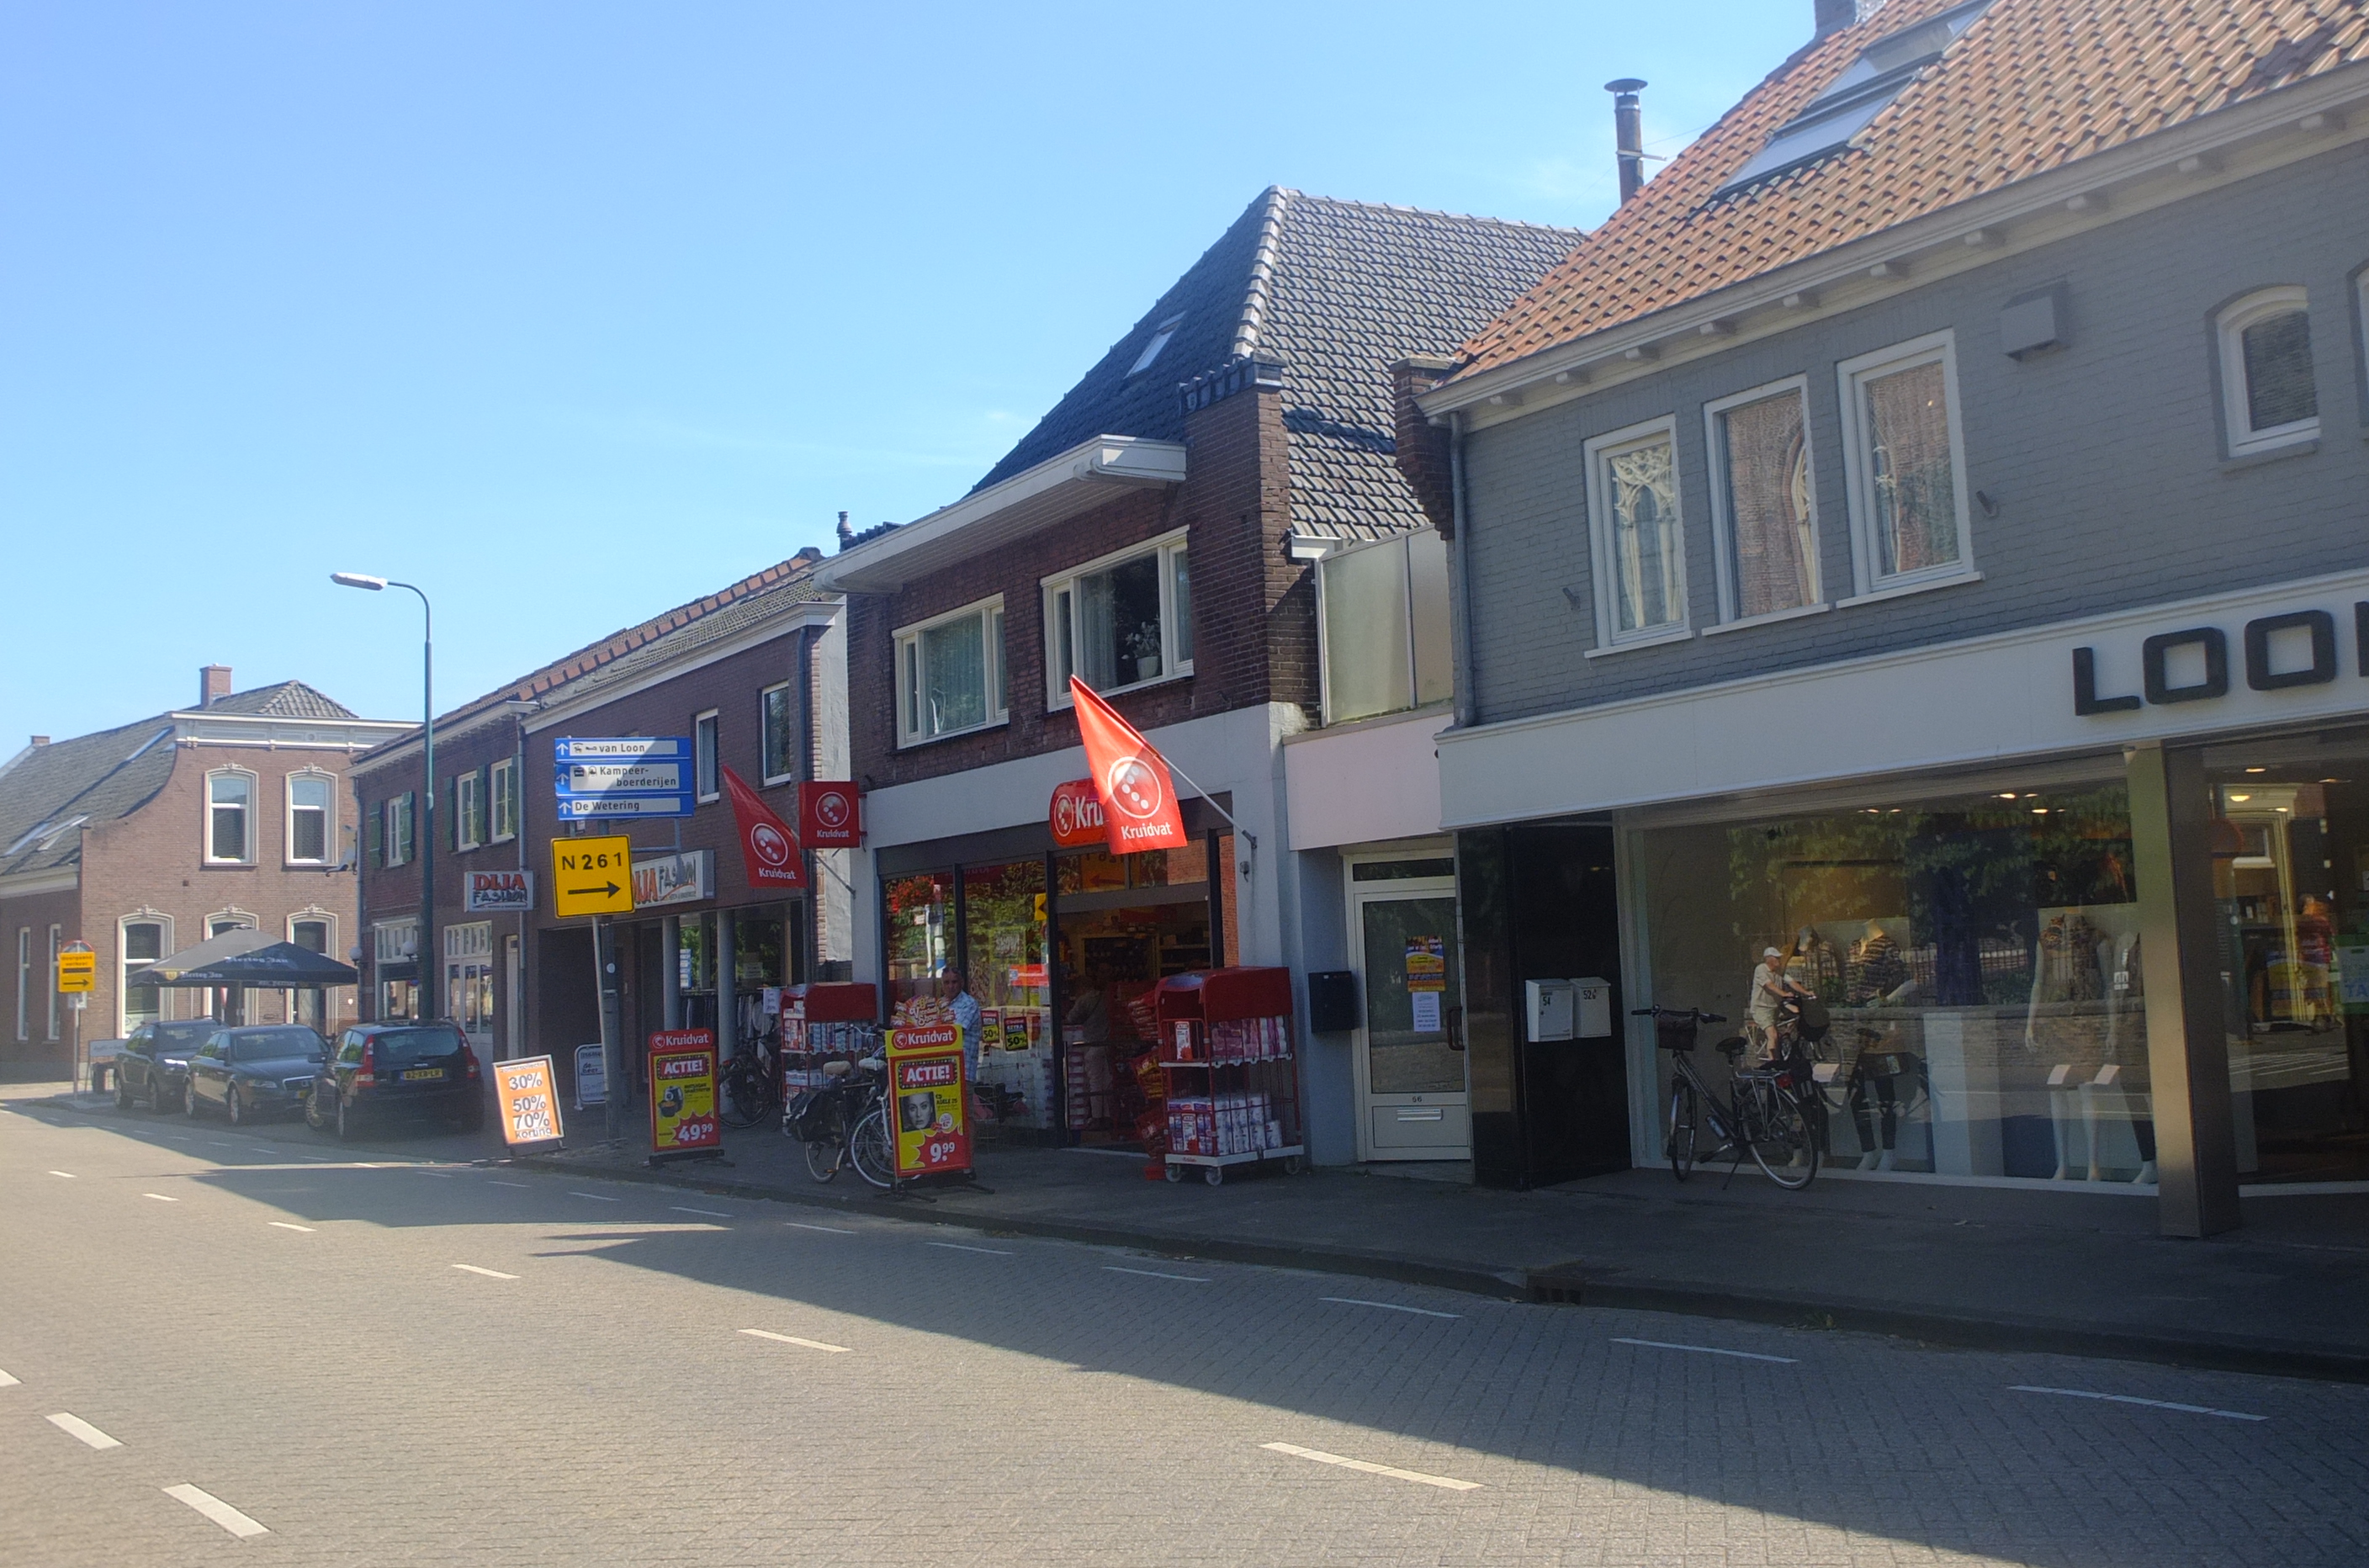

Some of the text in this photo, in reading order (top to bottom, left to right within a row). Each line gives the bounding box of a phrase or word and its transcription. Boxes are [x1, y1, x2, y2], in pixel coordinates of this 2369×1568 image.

[621, 744, 645, 752] Loon
[600, 766, 649, 776] Kampeer-
[617, 777, 676, 787] boerderijen
[575, 801, 640, 812] De Wetering
[816, 829, 850, 838] Kruidvat
[1121, 822, 1174, 840] Kruidvat
[758, 867, 797, 880] Kruidvat
[1543, 995, 1551, 1006] 54
[665, 1033, 709, 1046] Kruidvat
[908, 1030, 954, 1046] Kruidvat
[664, 1059, 703, 1075] ACTIE!
[906, 1065, 951, 1083] ACTIE!
[509, 1073, 543, 1090] 30%
[513, 1095, 547, 1112] 50%
[512, 1111, 550, 1129] 70%
[515, 1126, 553, 1139] korting
